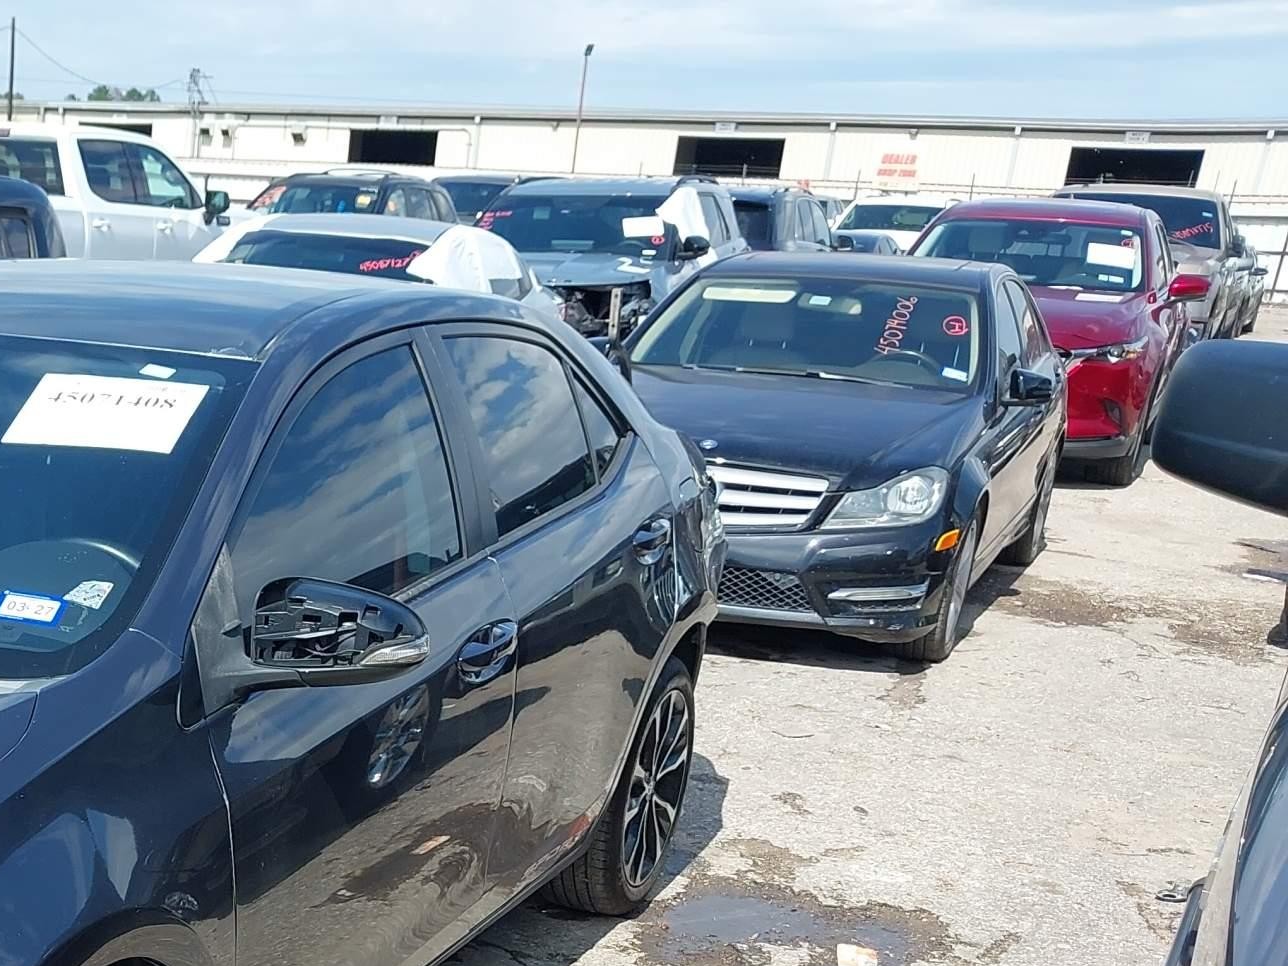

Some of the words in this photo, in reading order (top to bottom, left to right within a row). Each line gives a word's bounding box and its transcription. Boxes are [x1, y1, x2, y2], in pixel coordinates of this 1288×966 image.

[881, 153, 918, 165] DEALER
[48, 391, 178, 409] 45071408
[6, 600, 27, 613] 03
[33, 604, 56, 616] 27
